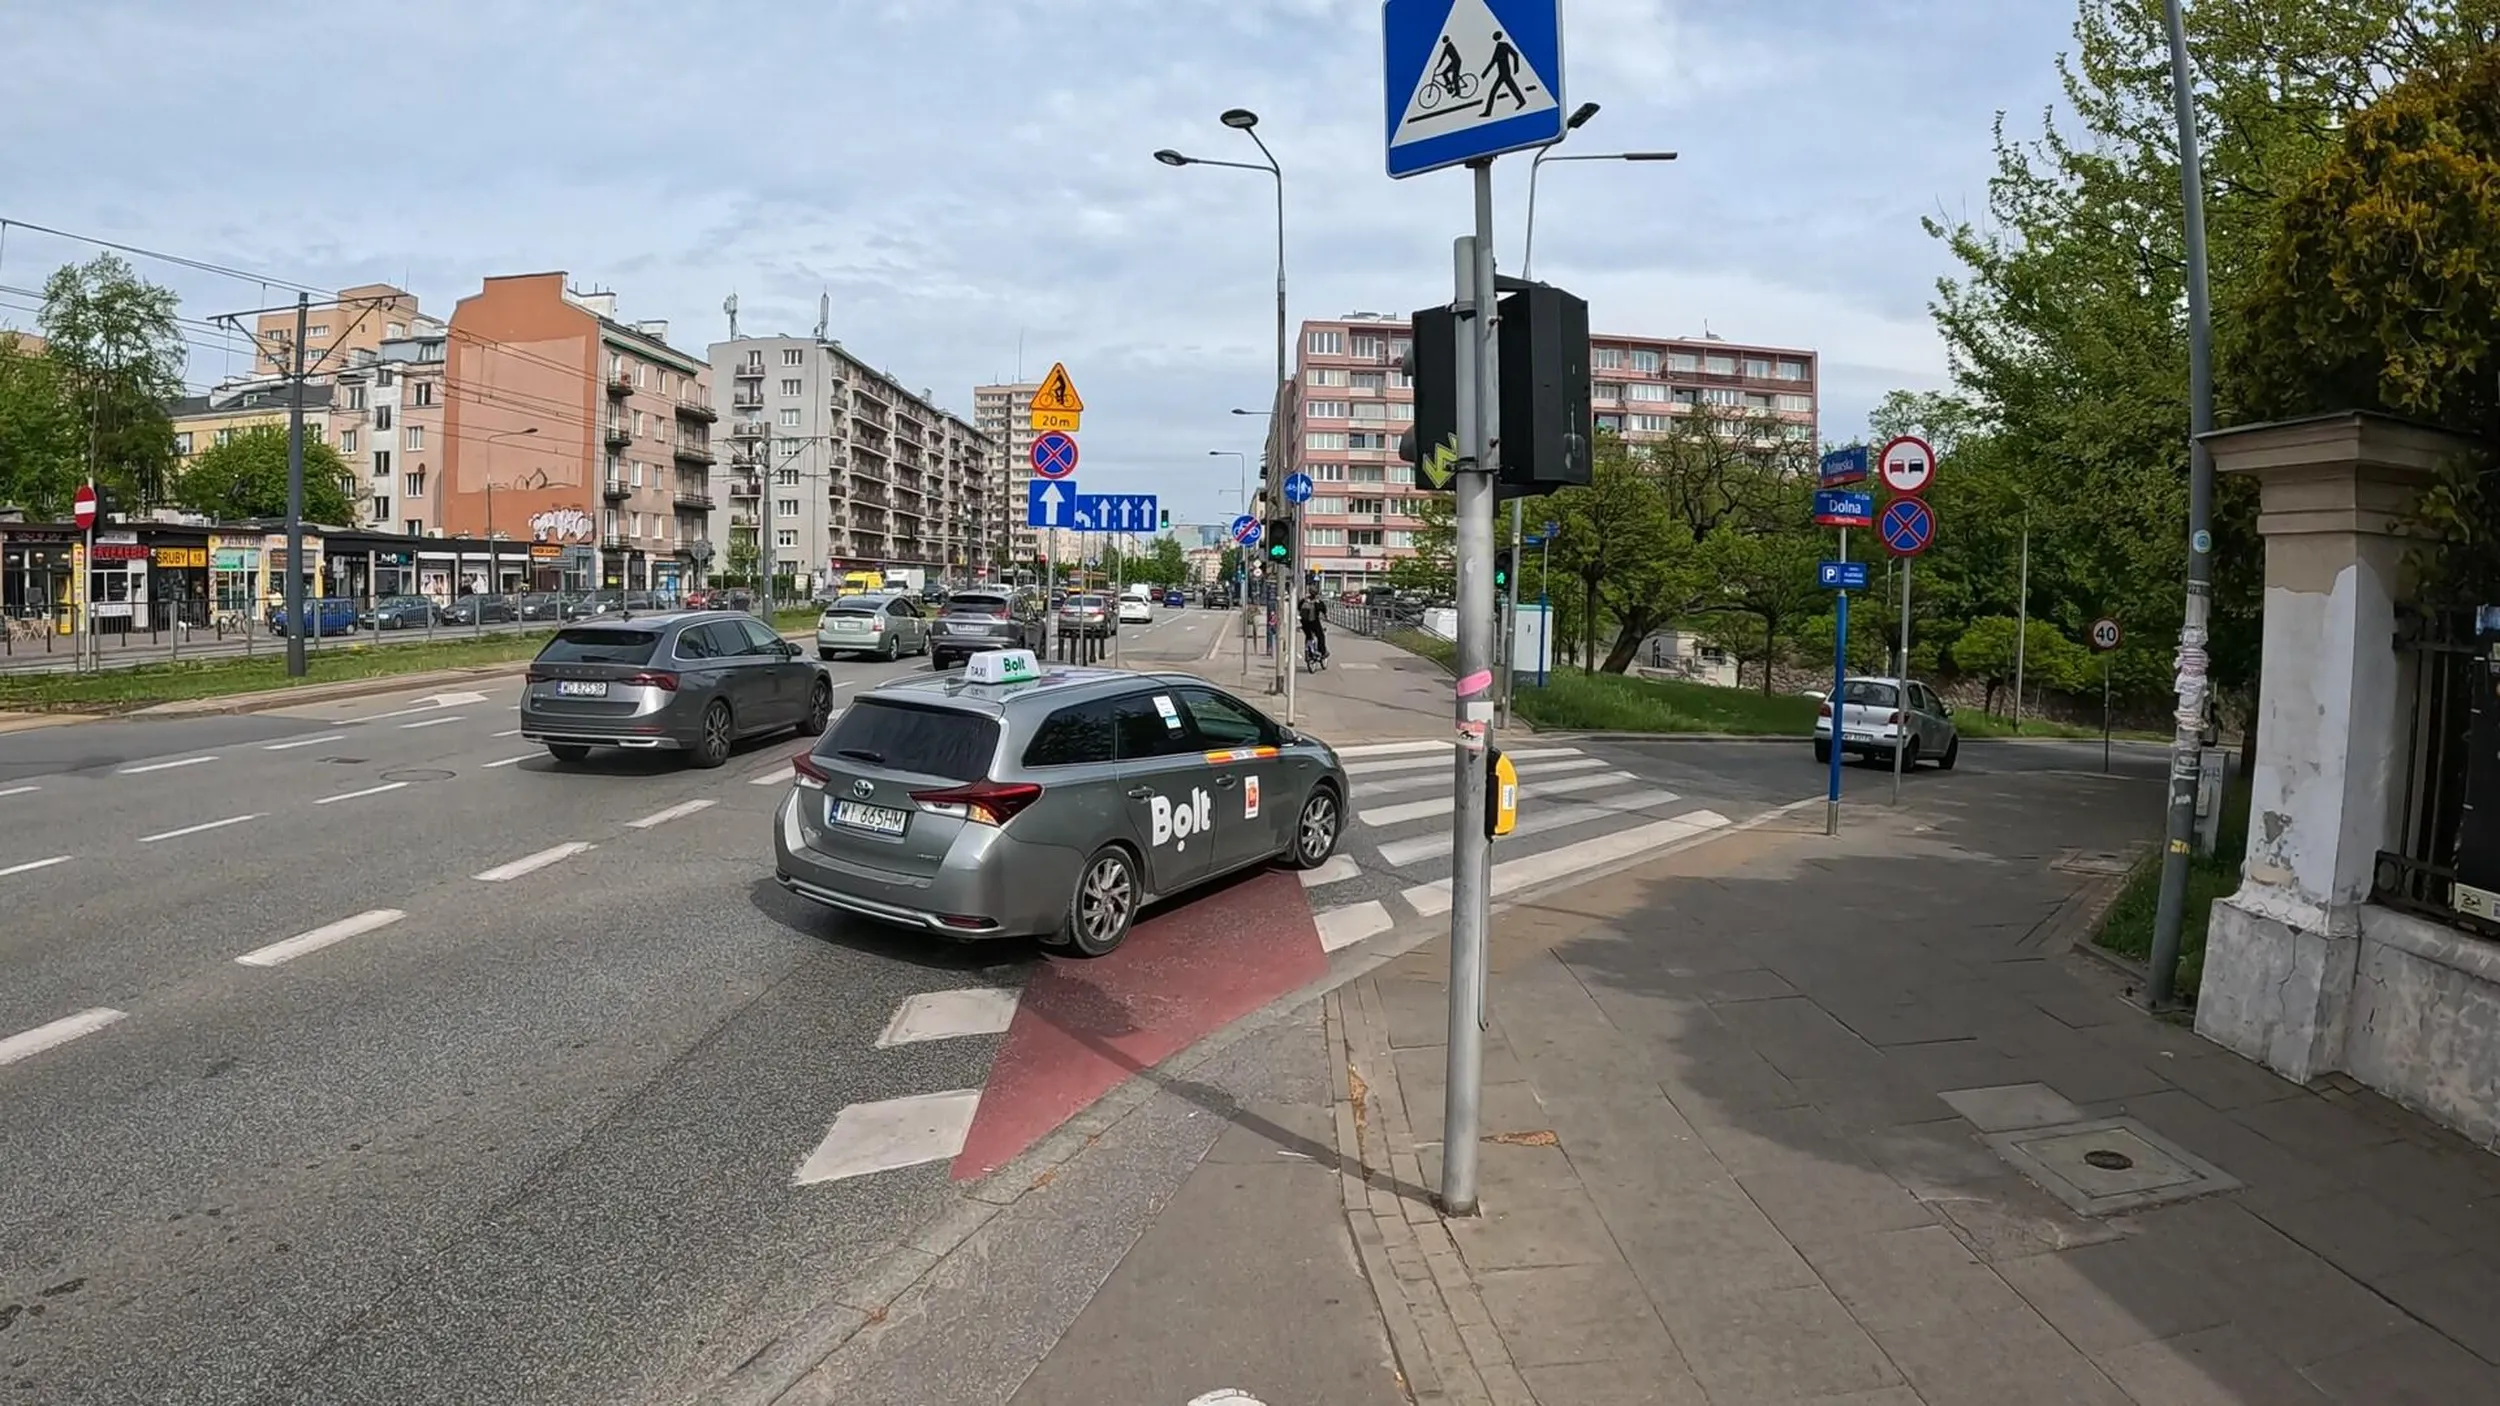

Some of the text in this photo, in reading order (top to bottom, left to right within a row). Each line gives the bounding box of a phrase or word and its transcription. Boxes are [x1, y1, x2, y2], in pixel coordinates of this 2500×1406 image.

[1829, 500, 1861, 514] Dolna
[1826, 568, 1836, 580] P
[2096, 626, 2117, 642] 40
[971, 656, 1026, 678] TAXI Bolt
[840, 802, 903, 830] WI 665HM
[1151, 786, 1211, 852] Bolt
